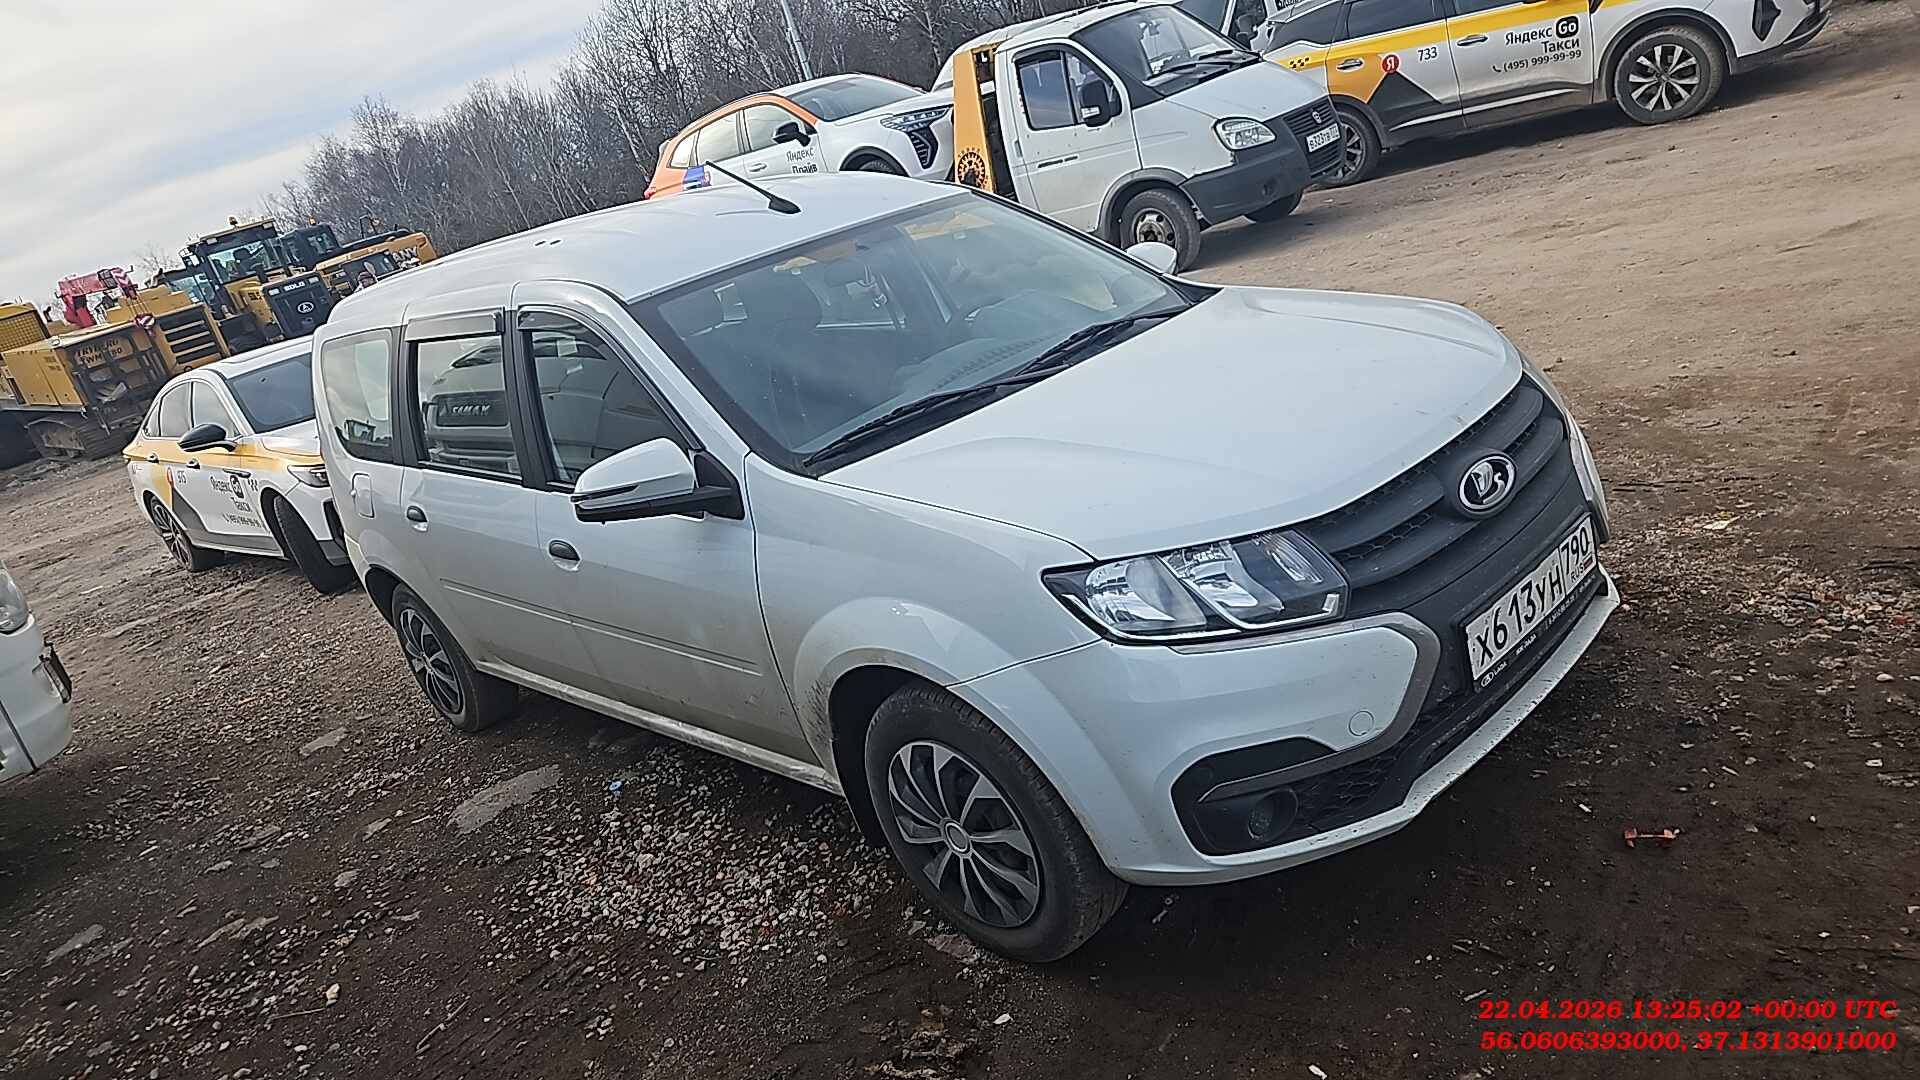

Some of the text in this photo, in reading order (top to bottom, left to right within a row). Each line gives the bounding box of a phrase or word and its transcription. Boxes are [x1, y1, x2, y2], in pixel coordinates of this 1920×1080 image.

[1558, 20, 1578, 35] Go
[1505, 26, 1553, 46] Яндекс
[1417, 46, 1438, 62] 733
[1541, 38, 1580, 54] Такси
[1386, 56, 1396, 72] Я
[1503, 49, 1582, 73] (495) 999-99-99
[786, 147, 815, 162] Яндекс
[393, 246, 419, 262] ANY
[1561, 526, 1589, 575] 790
